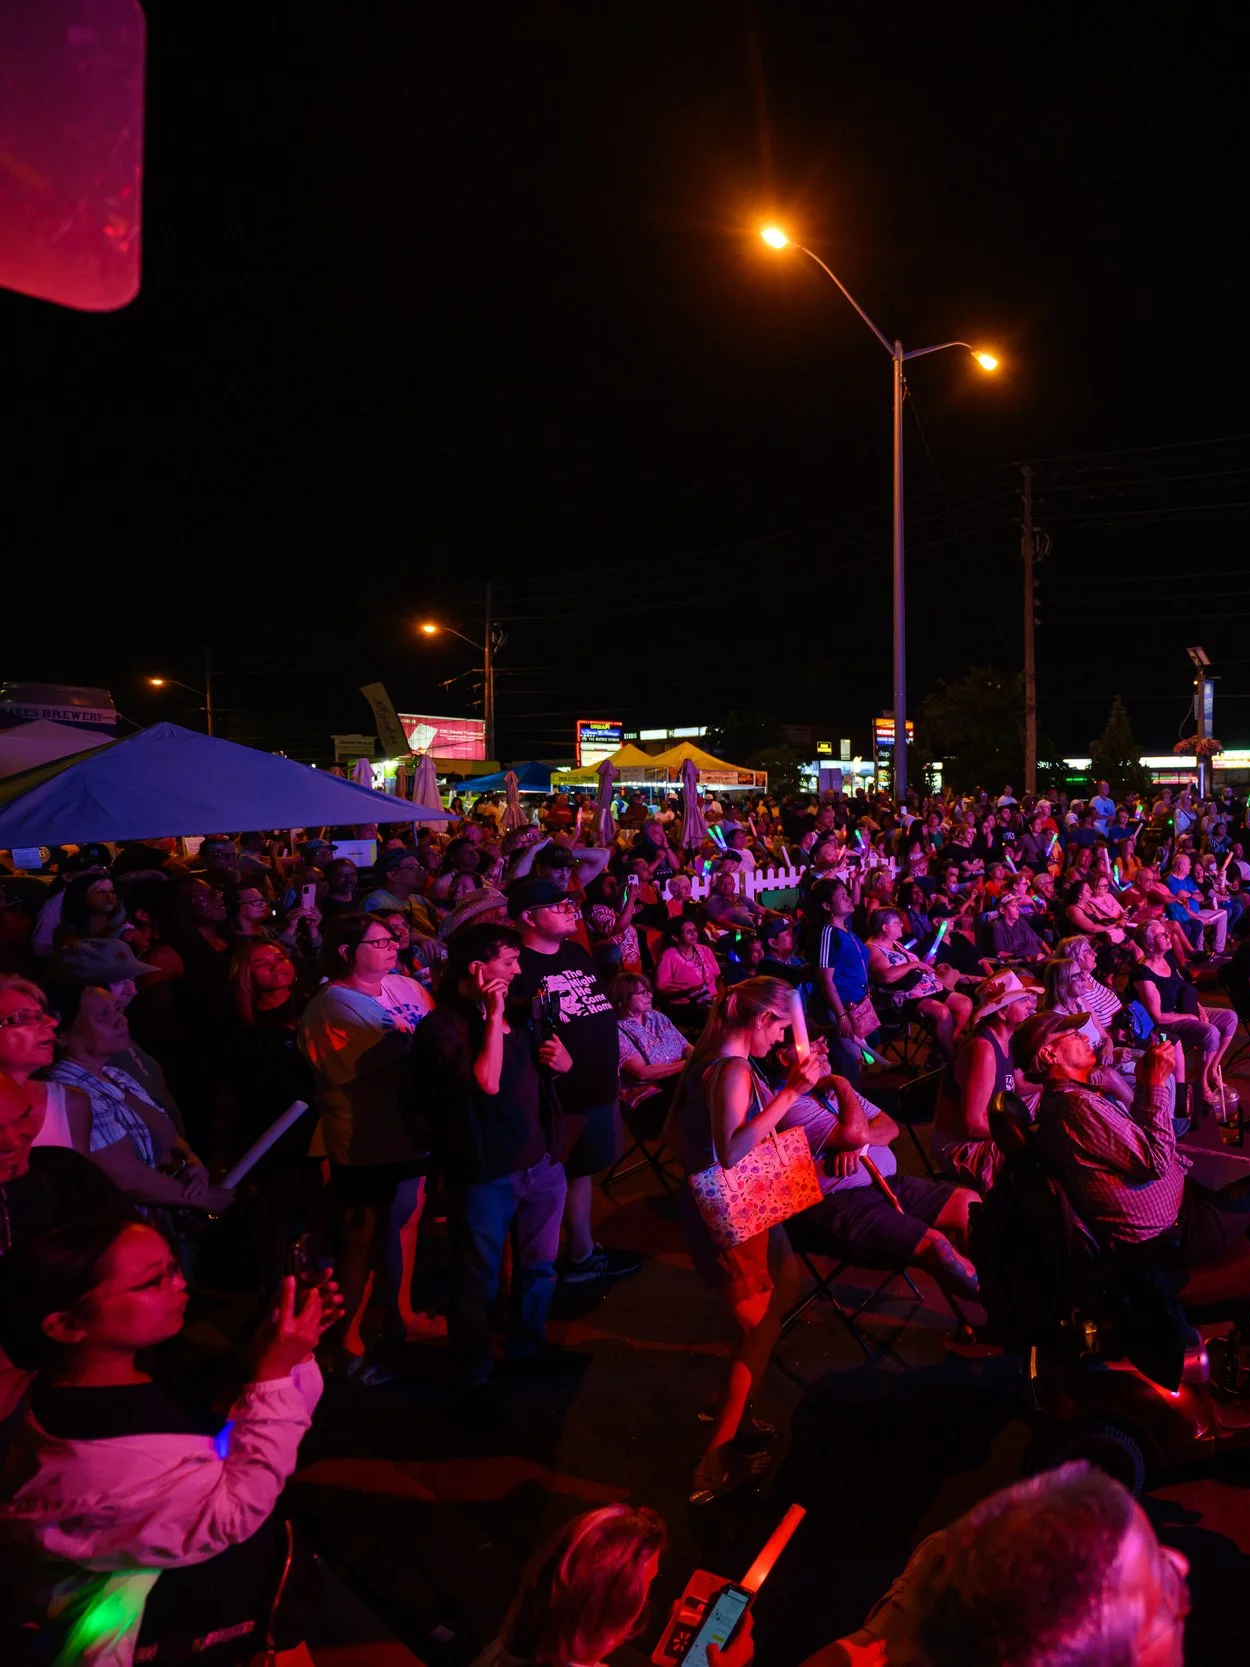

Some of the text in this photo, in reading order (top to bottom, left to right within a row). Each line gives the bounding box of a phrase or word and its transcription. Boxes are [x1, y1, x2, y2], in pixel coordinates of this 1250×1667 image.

[42, 709, 103, 721] BREWERY
[562, 970, 583, 979] The
[569, 975, 596, 988] Night
[575, 987, 592, 997] He
